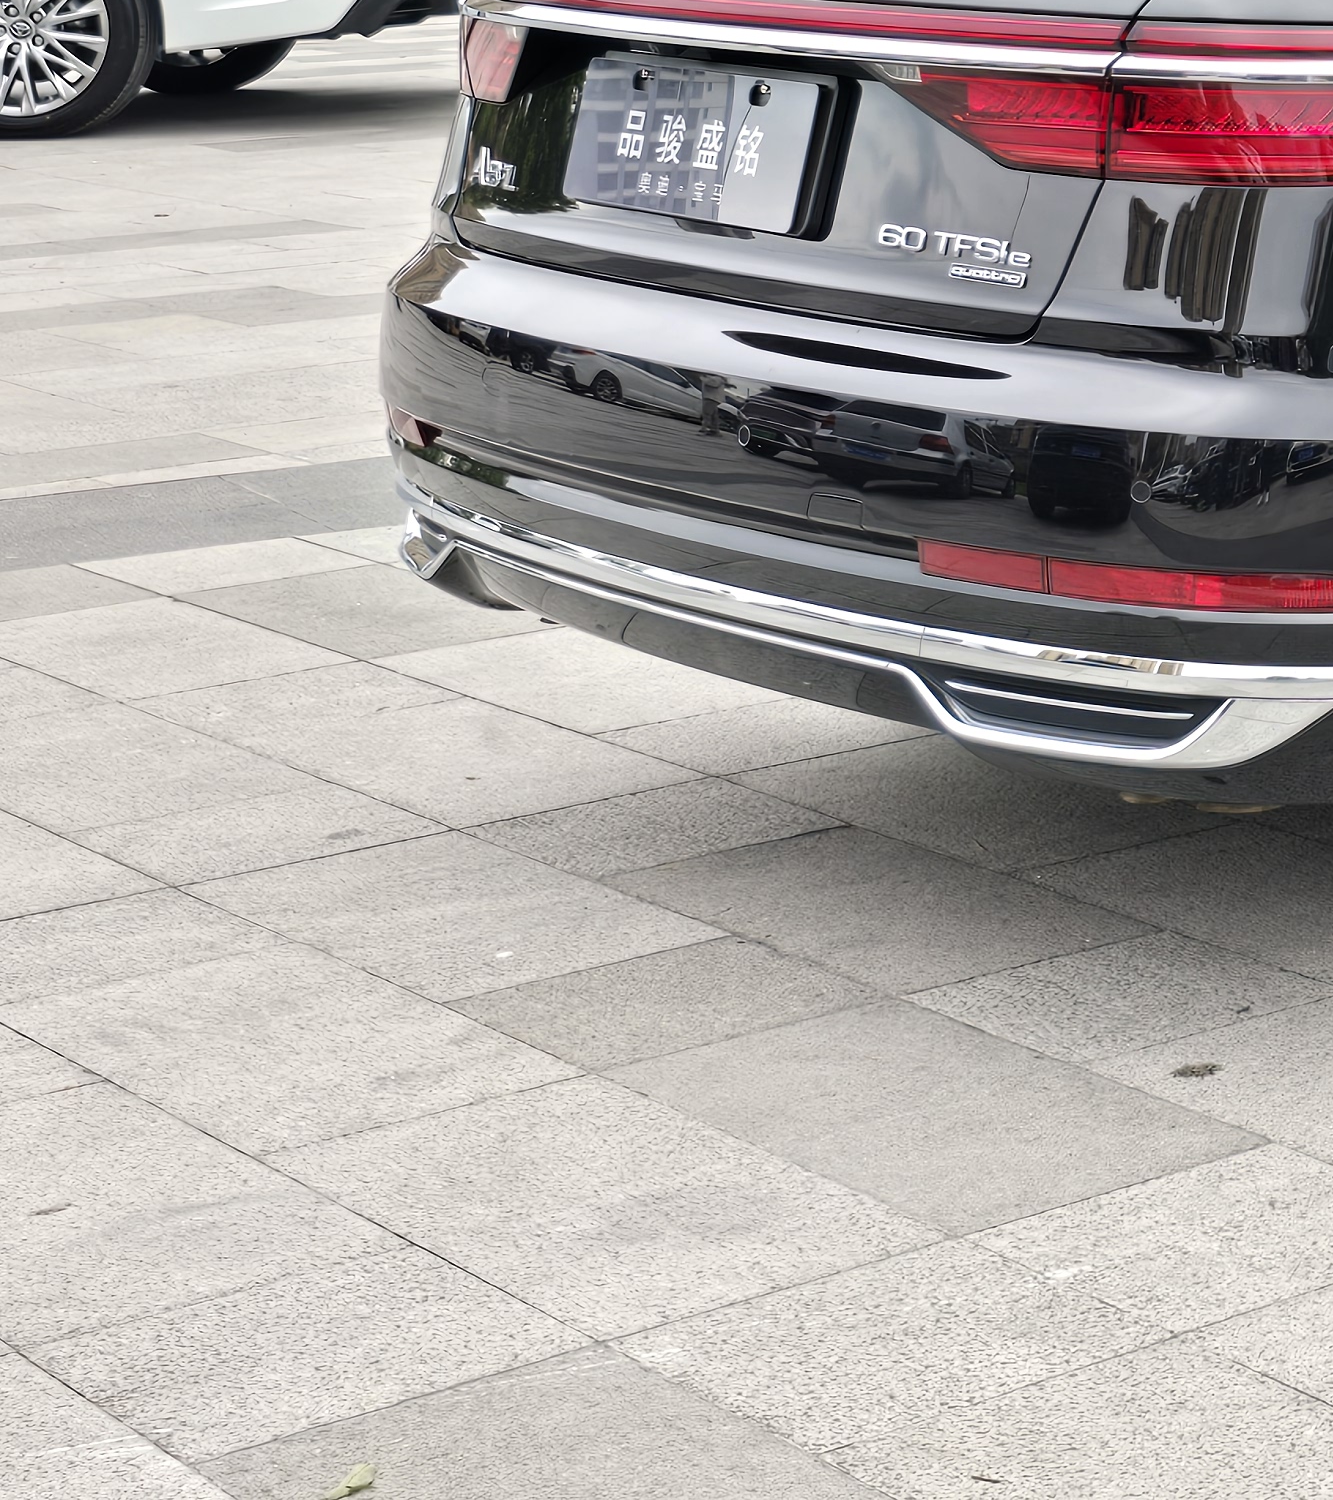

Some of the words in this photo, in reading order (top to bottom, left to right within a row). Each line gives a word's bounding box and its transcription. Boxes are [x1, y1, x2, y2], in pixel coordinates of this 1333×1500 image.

[617, 109, 765, 178] 品骏盛铭
[878, 223, 928, 252] 60
[950, 265, 1022, 284] quattro
